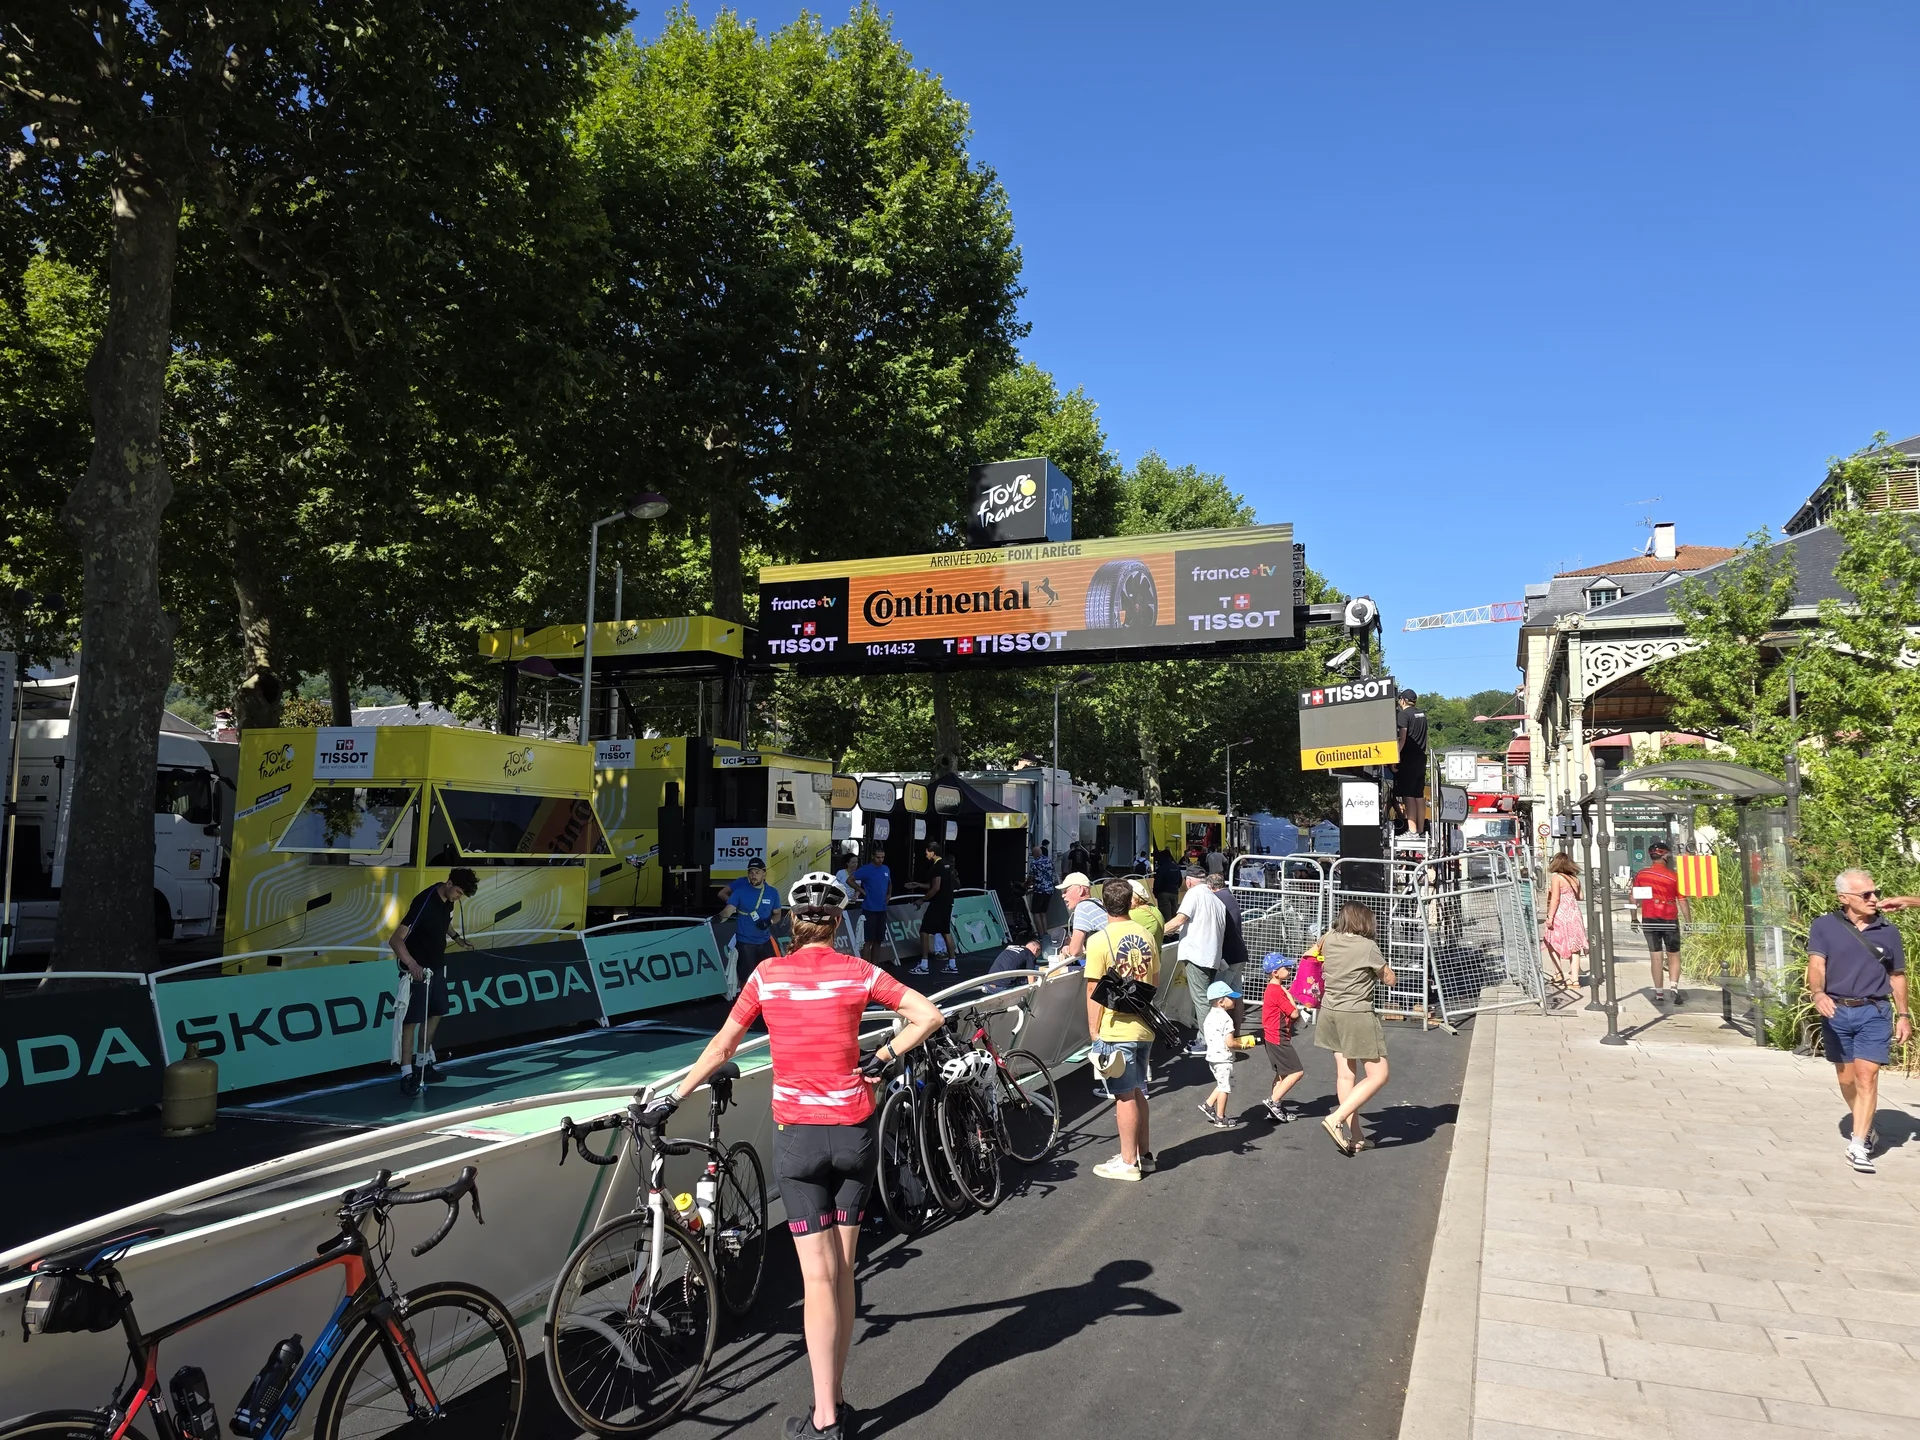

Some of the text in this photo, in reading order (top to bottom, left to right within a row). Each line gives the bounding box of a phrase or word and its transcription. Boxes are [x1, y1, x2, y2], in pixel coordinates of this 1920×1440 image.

[930, 552, 971, 568] ARRIVÉE
[974, 551, 998, 564] 2026
[1008, 549, 1033, 561] FOIX
[1041, 543, 1082, 558] ARIÈGE
[863, 580, 1032, 627] Continental
[1188, 610, 1281, 631] TISSOT
[768, 636, 838, 655] TISSOT
[975, 631, 1068, 653] TISSOT
[866, 642, 915, 656] 10:14:52
[1324, 679, 1392, 703] TISSOT
[320, 752, 368, 764] TISSOT
[599, 752, 631, 760] TISSOT
[1315, 746, 1372, 766] Continental
[21, 774, 31, 787] 80
[40, 774, 50, 787] 90
[911, 787, 922, 800] LCL
[875, 825, 888, 838] Krys
[717, 847, 763, 857] TISSOT
[1677, 842, 1715, 854] FOIX
[813, 1112, 829, 1120] GORE
